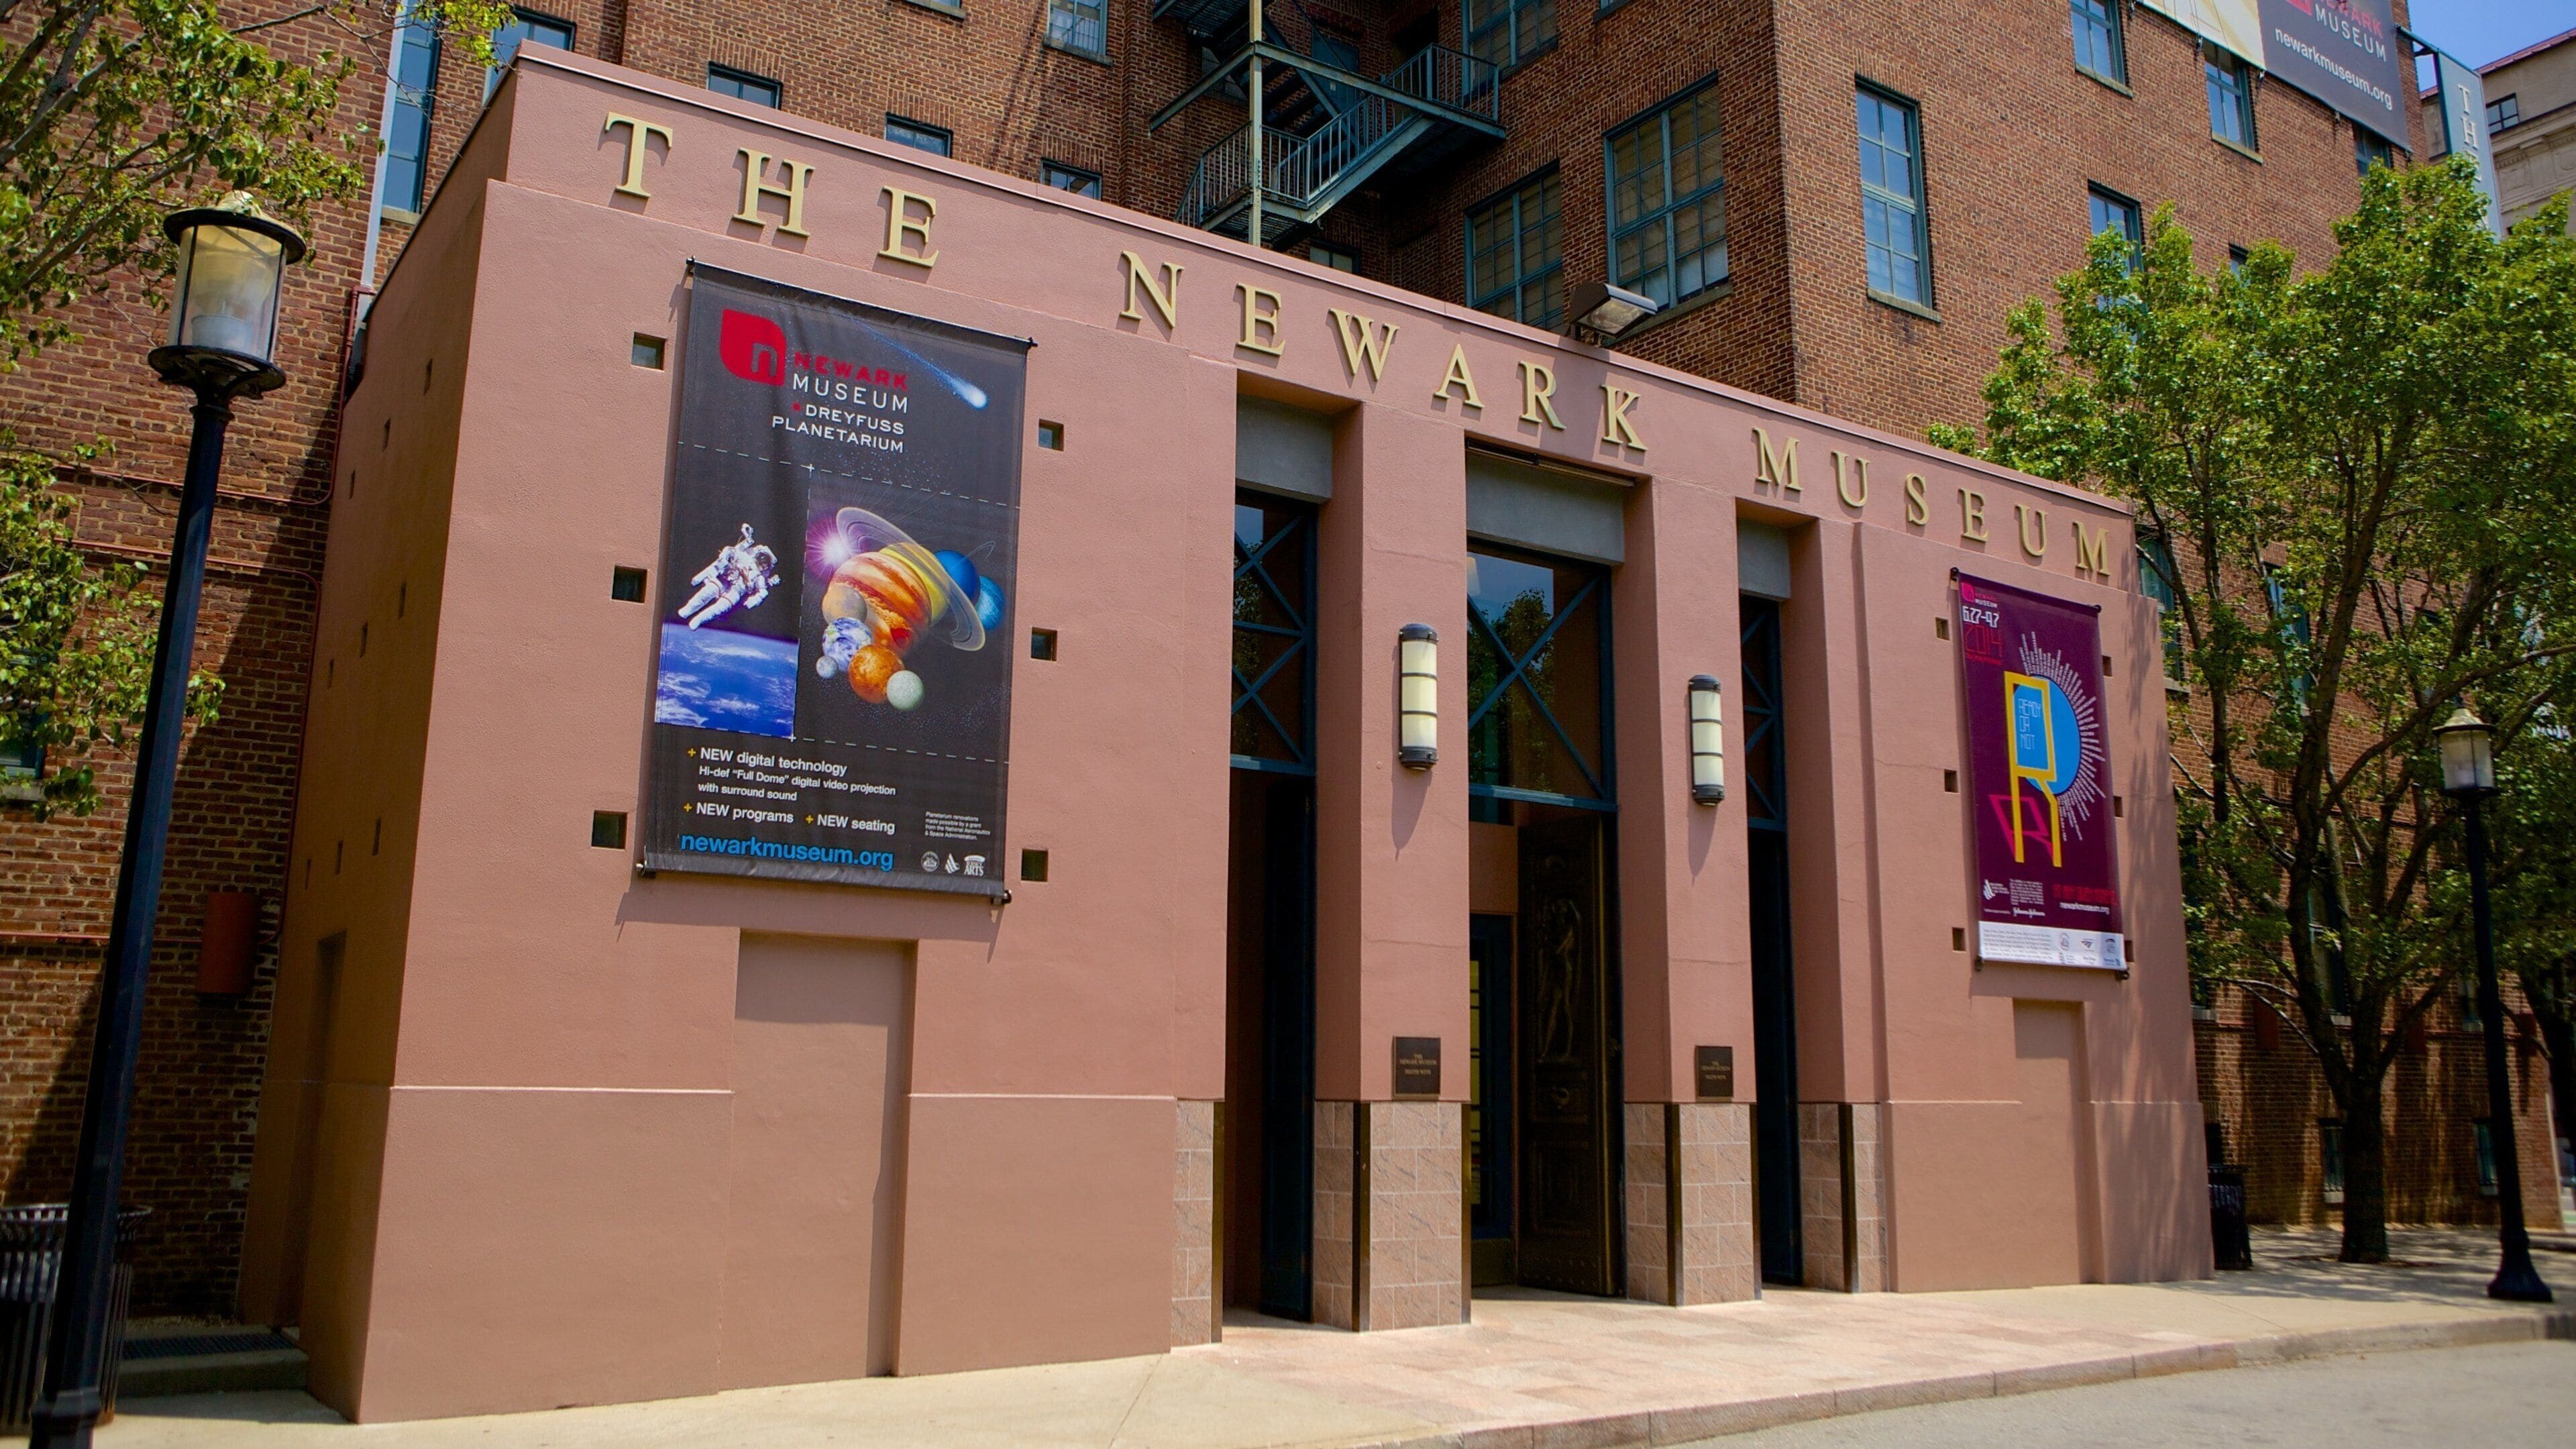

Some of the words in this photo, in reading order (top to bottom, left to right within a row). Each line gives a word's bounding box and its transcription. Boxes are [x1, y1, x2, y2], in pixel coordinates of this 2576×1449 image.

[2315, 3, 2386, 62] MUSEUM
[2321, 0, 2382, 39] WARK
[2275, 28, 2392, 111] newarkmuseum.org
[605, 111, 939, 268] THE
[1119, 250, 1648, 451] NEWARK
[1752, 427, 2111, 576] MUSEUM
[794, 351, 909, 391] NEWARK
[792, 373, 908, 413] MUSEUM
[772, 415, 904, 453] PLANETARIUM
[805, 404, 905, 435] DREYFUSS
[700, 747, 733, 763] NEW
[737, 751, 775, 767] digital
[778, 757, 847, 777] technology
[698, 783, 718, 794] with
[721, 786, 765, 798] surround
[767, 791, 797, 802] sound
[699, 765, 731, 778] Hi-def
[792, 776, 820, 789] digital
[823, 780, 848, 791] video
[851, 783, 896, 796] projection
[696, 802, 730, 817] NEW
[733, 808, 794, 824] programs
[817, 814, 849, 828] NEW
[851, 818, 896, 836] seating
[926, 811, 953, 819] Planetarium
[680, 835, 894, 871] newarkmuseum.org
[964, 865, 984, 876] ARTS
